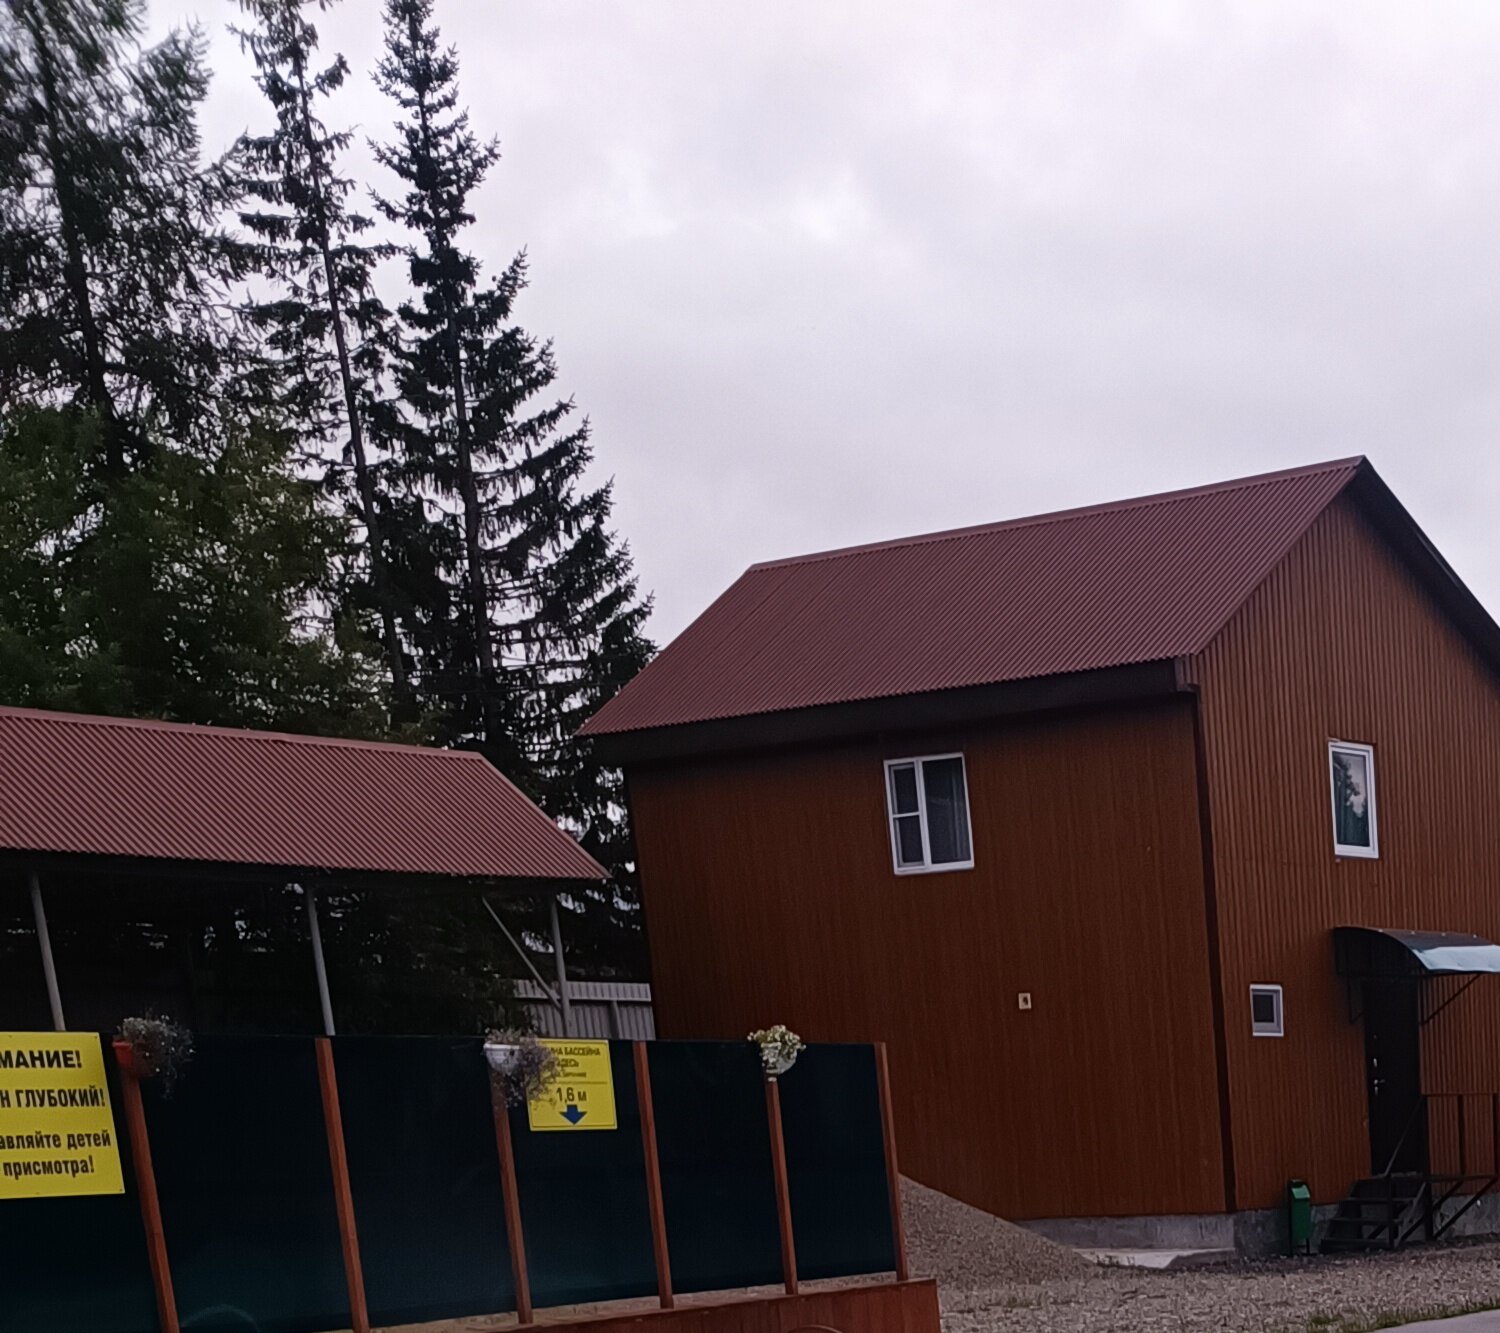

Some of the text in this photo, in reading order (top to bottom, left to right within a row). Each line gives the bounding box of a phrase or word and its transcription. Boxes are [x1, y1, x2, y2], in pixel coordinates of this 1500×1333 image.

[15, 1085, 106, 1108] ГЛУБОКИЙ!
[556, 1087, 575, 1103] 1,6
[67, 1130, 111, 1150] детей
[3, 1155, 95, 1180] присмотра!
